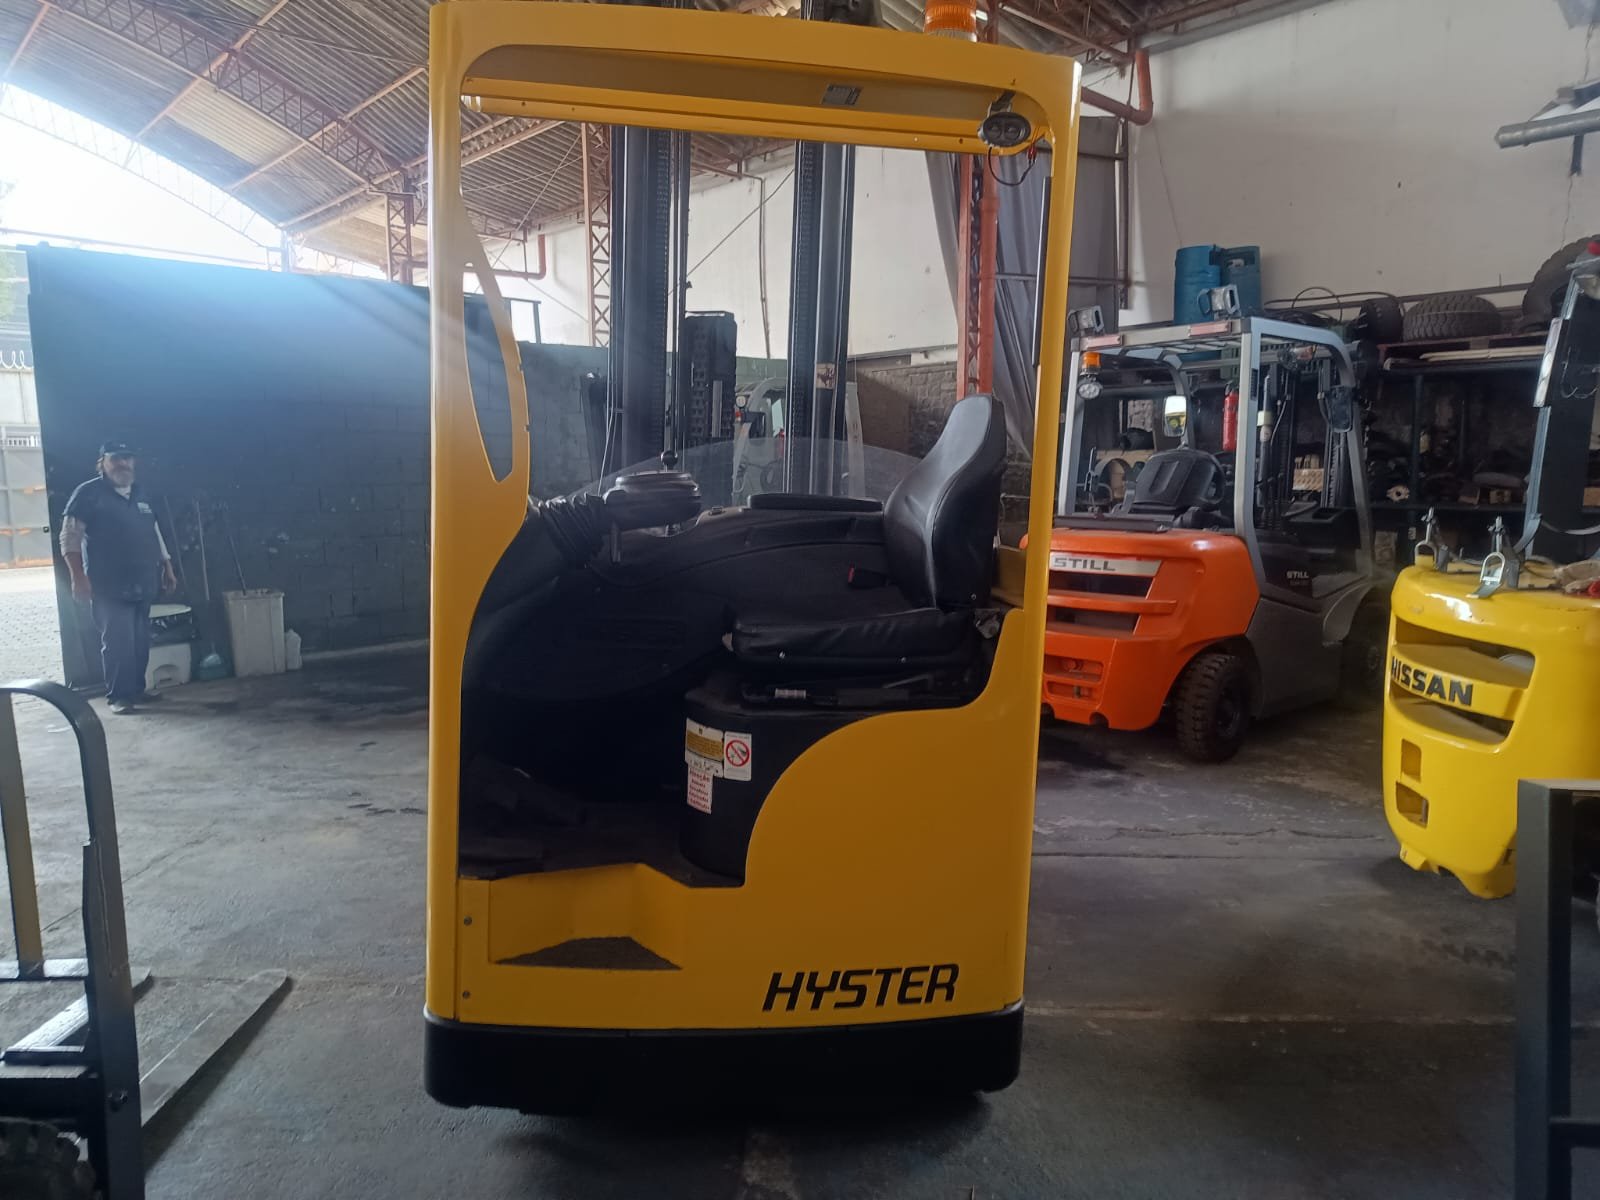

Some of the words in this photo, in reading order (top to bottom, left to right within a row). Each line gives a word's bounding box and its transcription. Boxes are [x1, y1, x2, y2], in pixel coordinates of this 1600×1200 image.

[1053, 557, 1116, 571] STILL
[1391, 655, 1474, 707] NISSAN
[762, 963, 960, 1012] HYSTER
